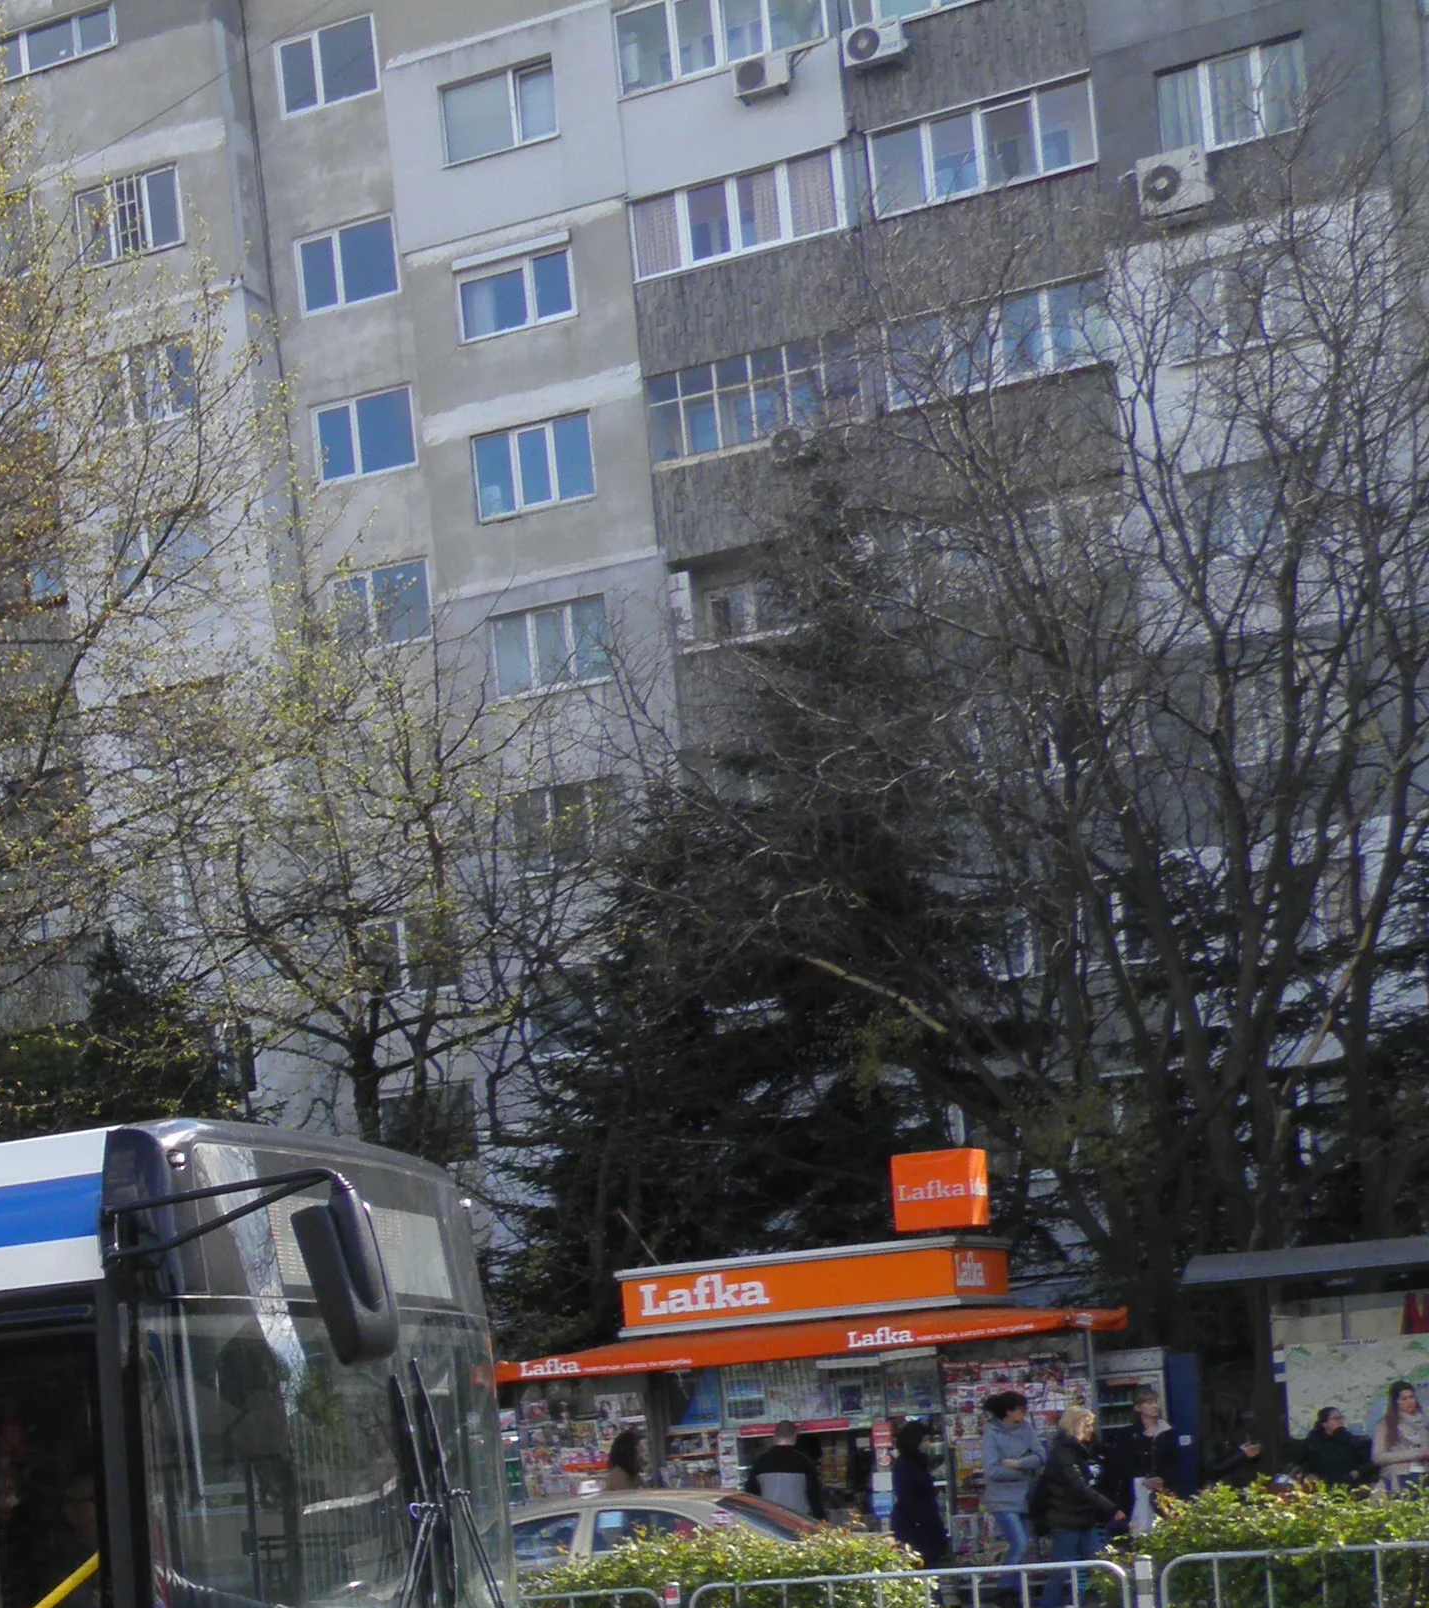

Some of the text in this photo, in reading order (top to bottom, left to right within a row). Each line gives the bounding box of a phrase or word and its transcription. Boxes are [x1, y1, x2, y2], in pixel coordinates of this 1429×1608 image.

[896, 1179, 966, 1202] Lafka
[954, 1250, 986, 1287] Lafka
[638, 1273, 771, 1317] Lafka
[847, 1326, 915, 1348] Lafka
[519, 1358, 581, 1377] Lafka
